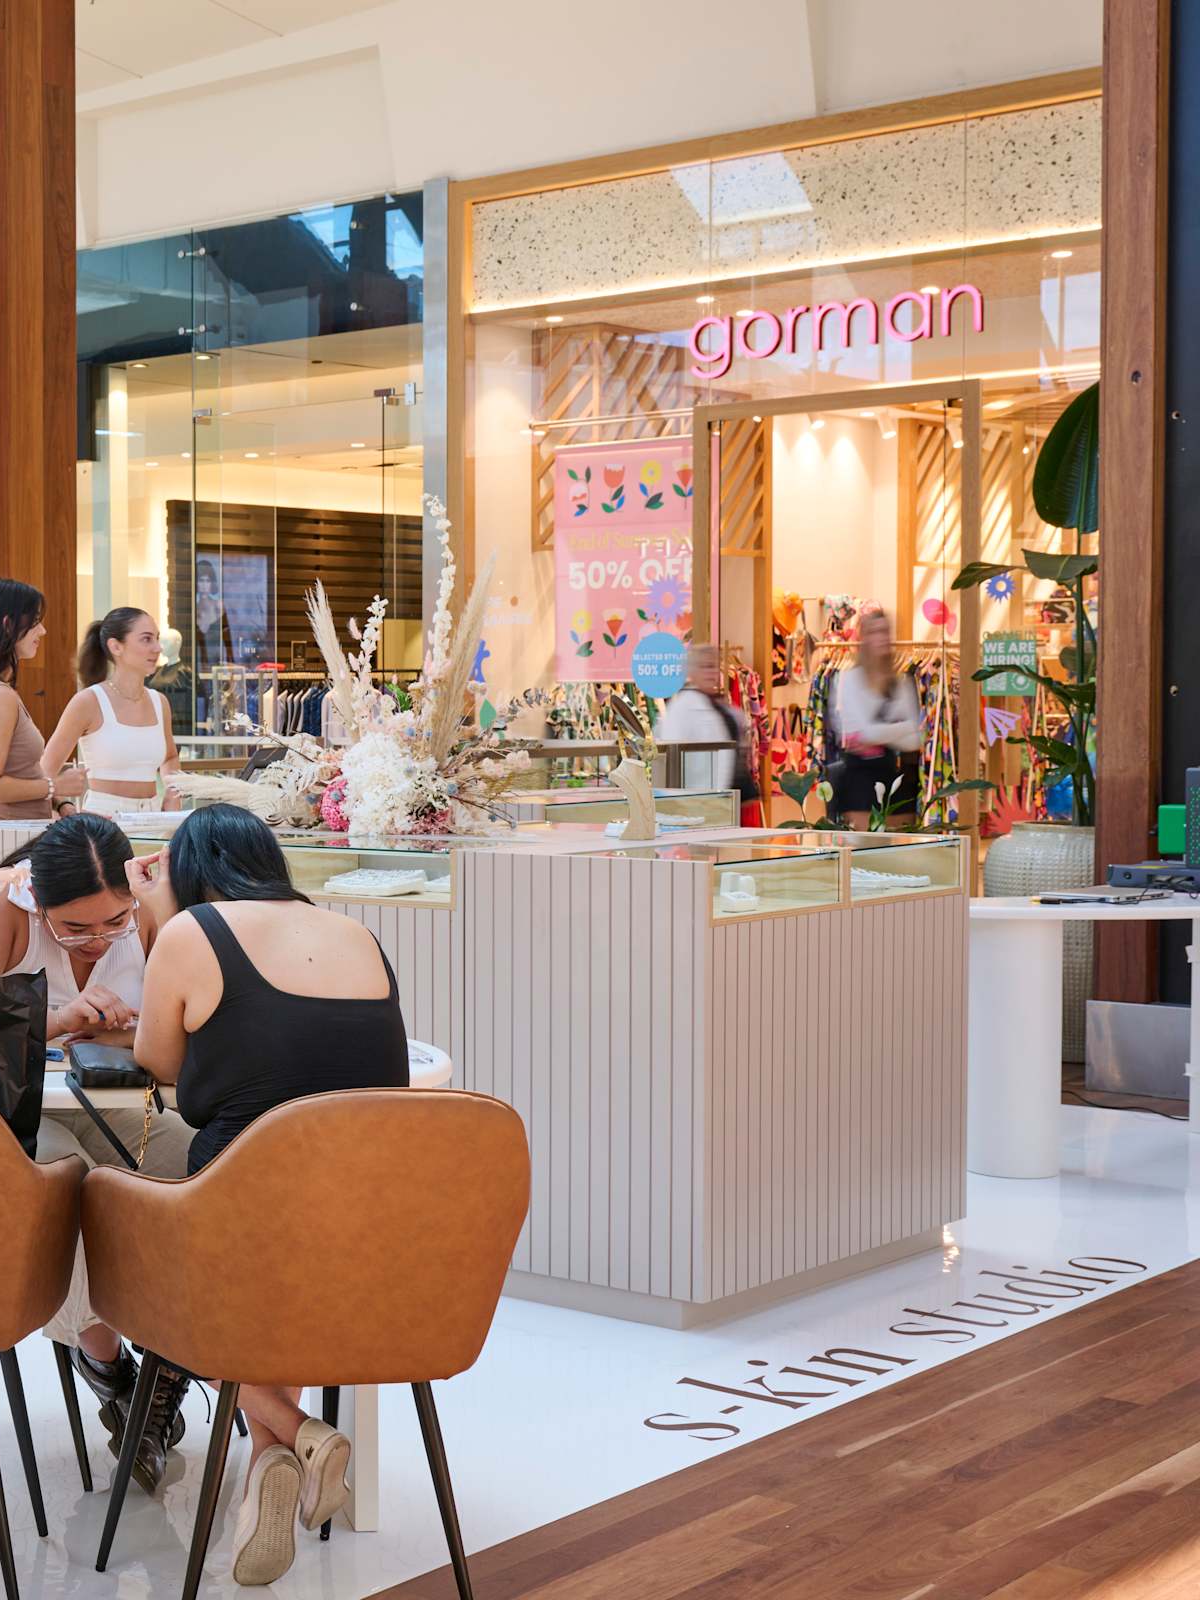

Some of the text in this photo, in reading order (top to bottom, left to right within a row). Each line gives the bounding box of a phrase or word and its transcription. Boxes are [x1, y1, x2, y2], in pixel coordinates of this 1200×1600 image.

[690, 284, 984, 378] gorman
[569, 560, 632, 590] 50%
[983, 641, 1035, 653] WE ARE
[638, 664, 683, 676] 50% OFF
[983, 654, 1036, 666] HIRING!
[643, 1256, 1148, 1441] s-kin studio
